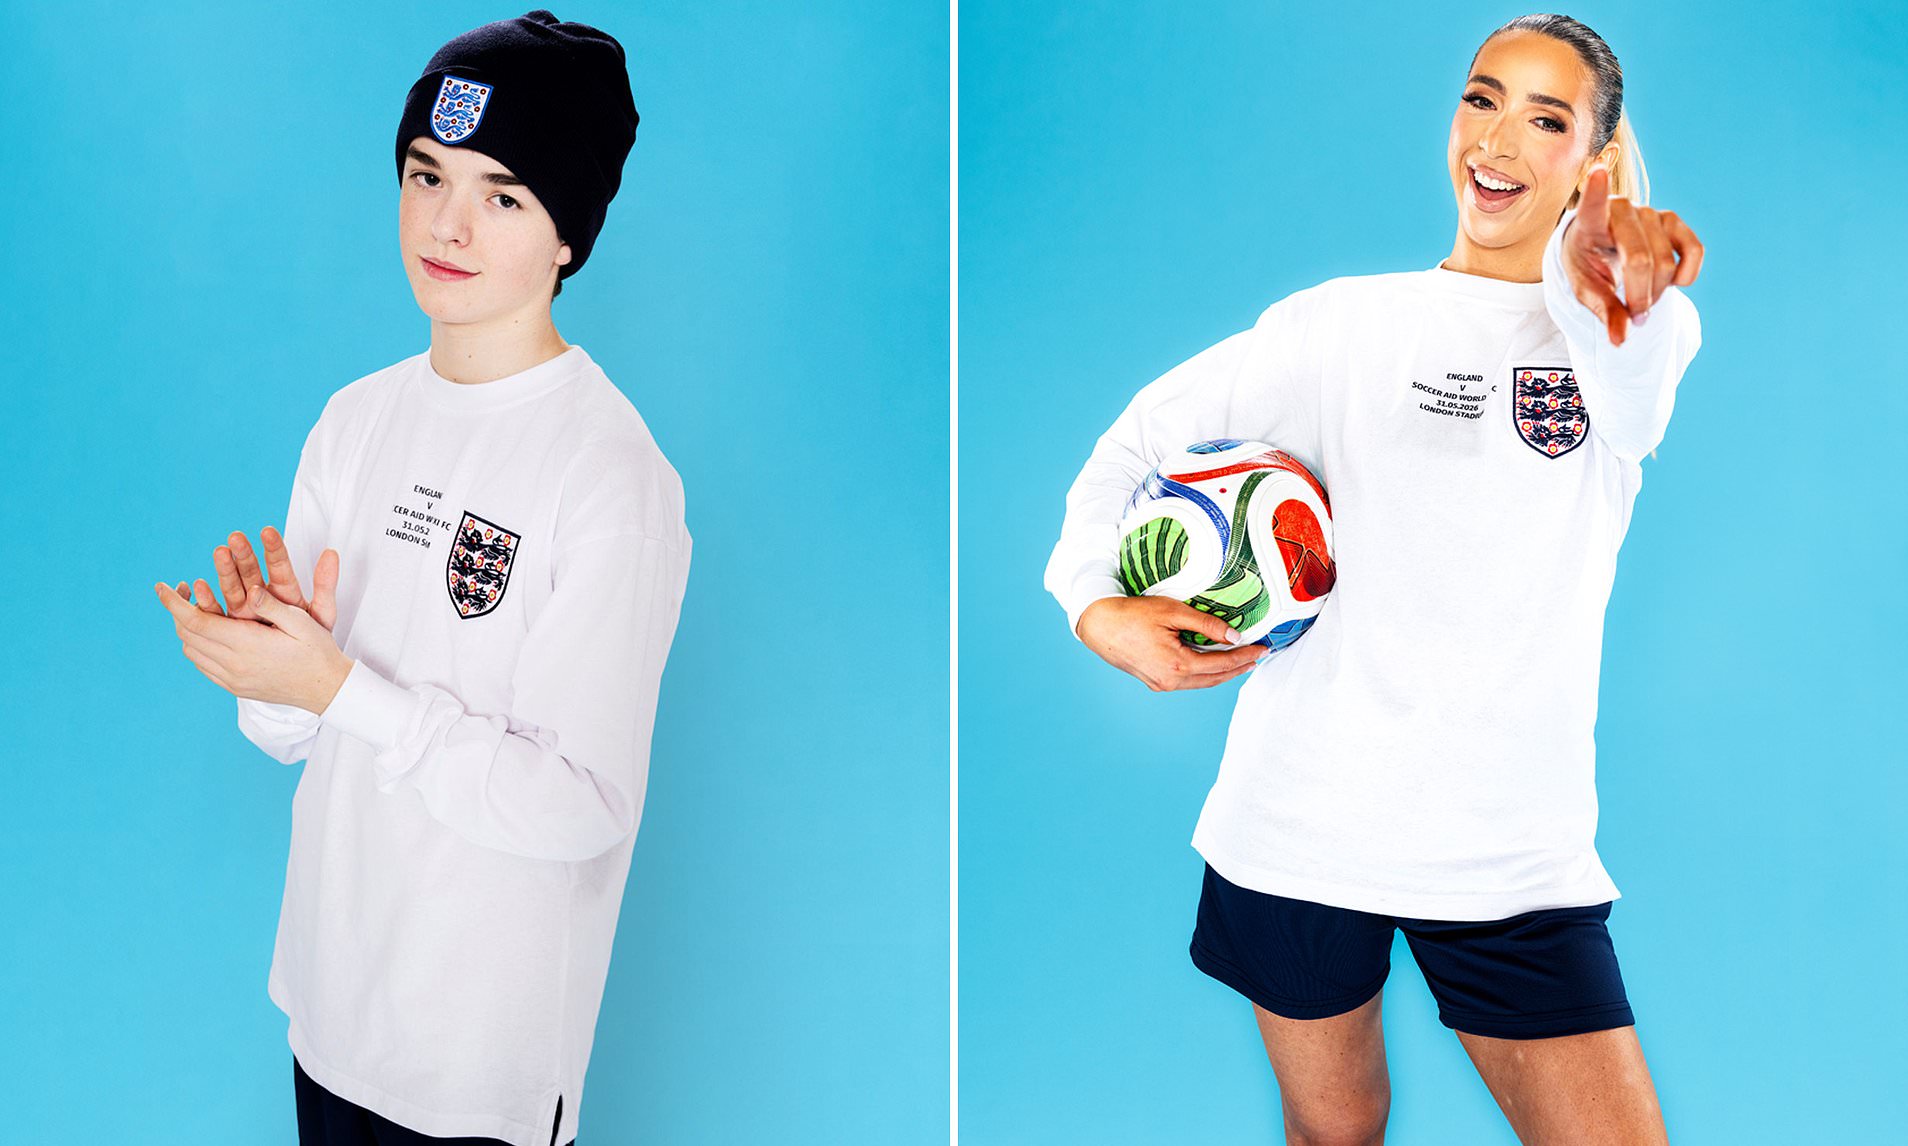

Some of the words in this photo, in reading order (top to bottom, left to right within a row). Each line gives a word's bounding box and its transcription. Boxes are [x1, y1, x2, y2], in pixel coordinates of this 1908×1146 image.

[1446, 373, 1483, 382] ENGLAND
[1411, 381, 1443, 397] SOCCER
[1443, 392, 1457, 400] AID
[1419, 402, 1454, 416] LONDON
[414, 485, 443, 499] ENGLAN
[427, 501, 433, 510] V
[393, 505, 409, 516] CER
[410, 510, 425, 520] AID
[441, 521, 451, 531] FC
[385, 528, 420, 544] LONDON
